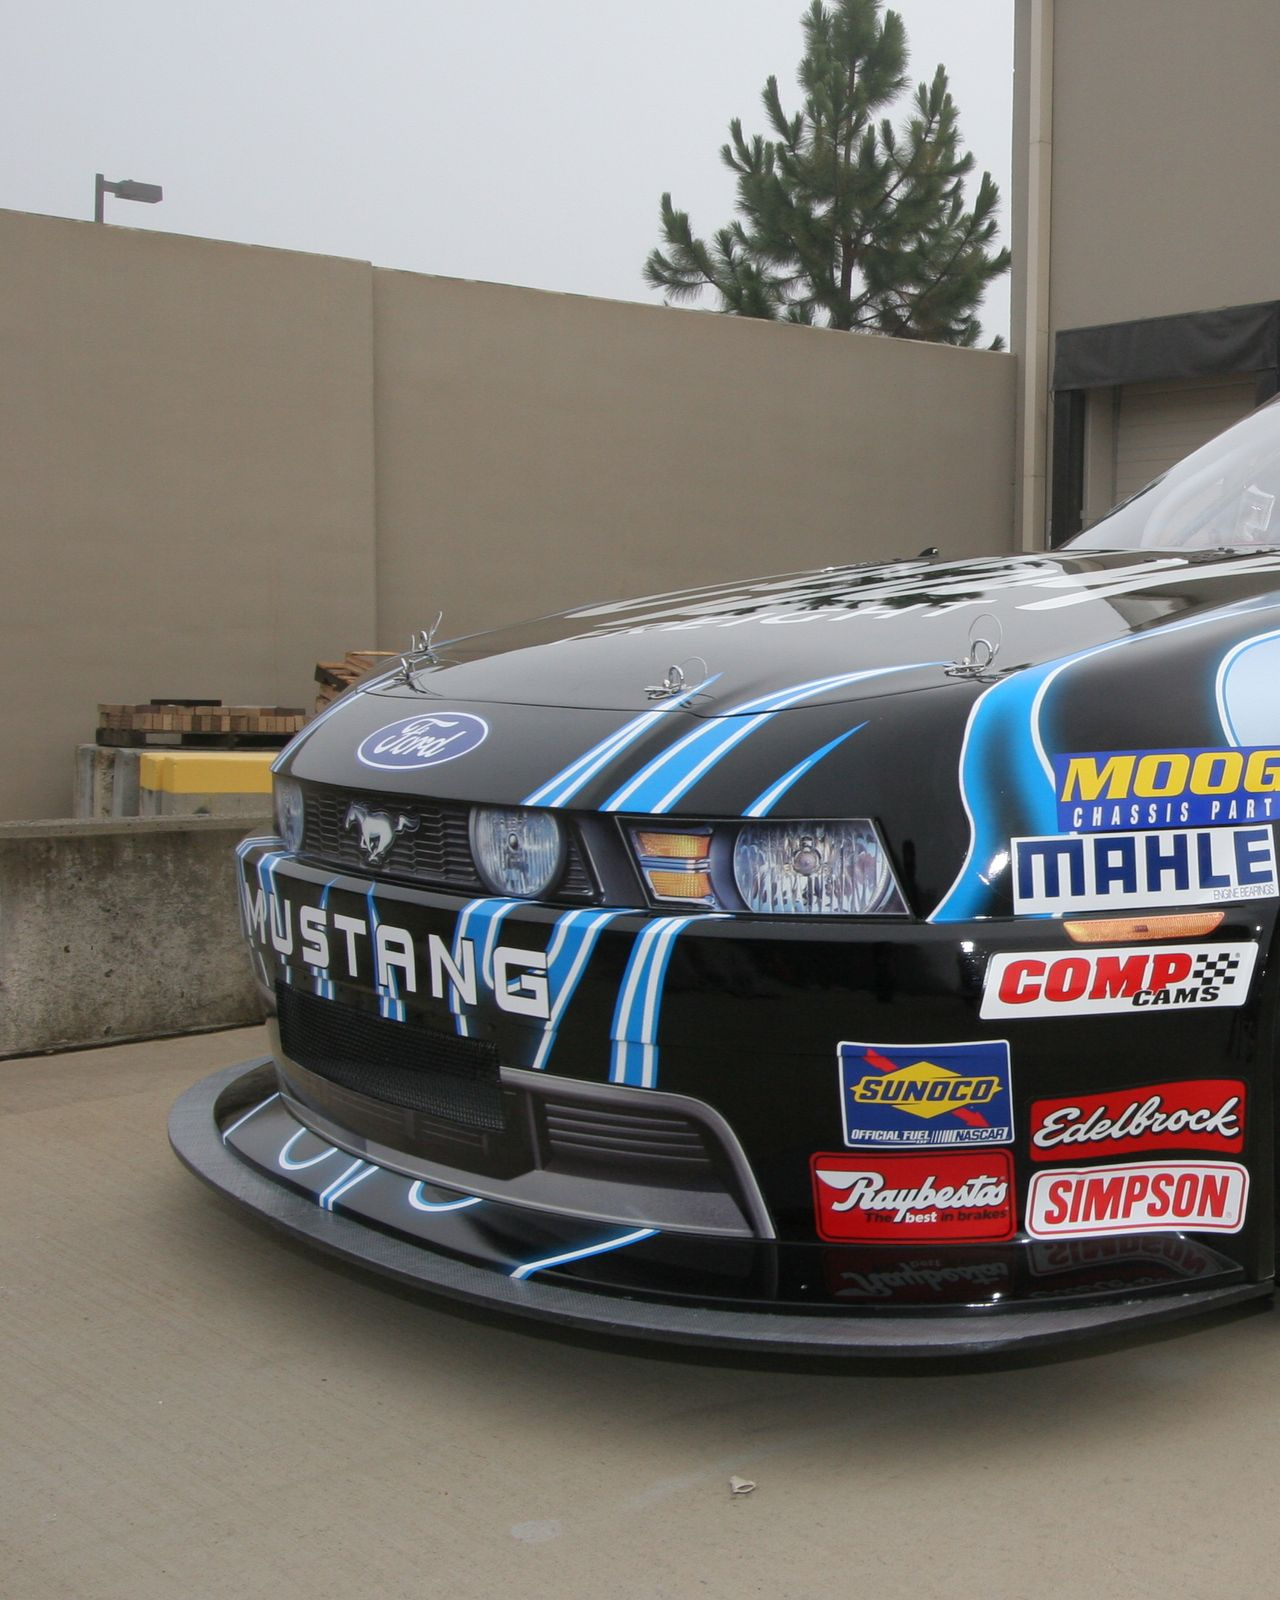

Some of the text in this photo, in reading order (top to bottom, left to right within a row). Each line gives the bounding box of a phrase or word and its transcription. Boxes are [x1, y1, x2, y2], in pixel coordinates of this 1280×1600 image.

[373, 716, 470, 758] Ford
[1073, 806, 1189, 828] CHASSIS
[1016, 829, 1273, 900] MAHLE
[1213, 884, 1275, 900] ENGINE BEARINGS
[243, 881, 552, 1021] MUSTANG
[998, 953, 1192, 1004] COMP
[1132, 986, 1220, 1006] CAMS
[855, 1077, 1000, 1103] SUNOCO
[851, 1128, 1006, 1142] OFFICIAL FUEL NASCAR
[1032, 1096, 1240, 1149] Edelbrock
[816, 1170, 1008, 1223] Raybestos
[865, 1209, 1008, 1223] The best in brakes
[1044, 1172, 1231, 1226] SIMPSON
